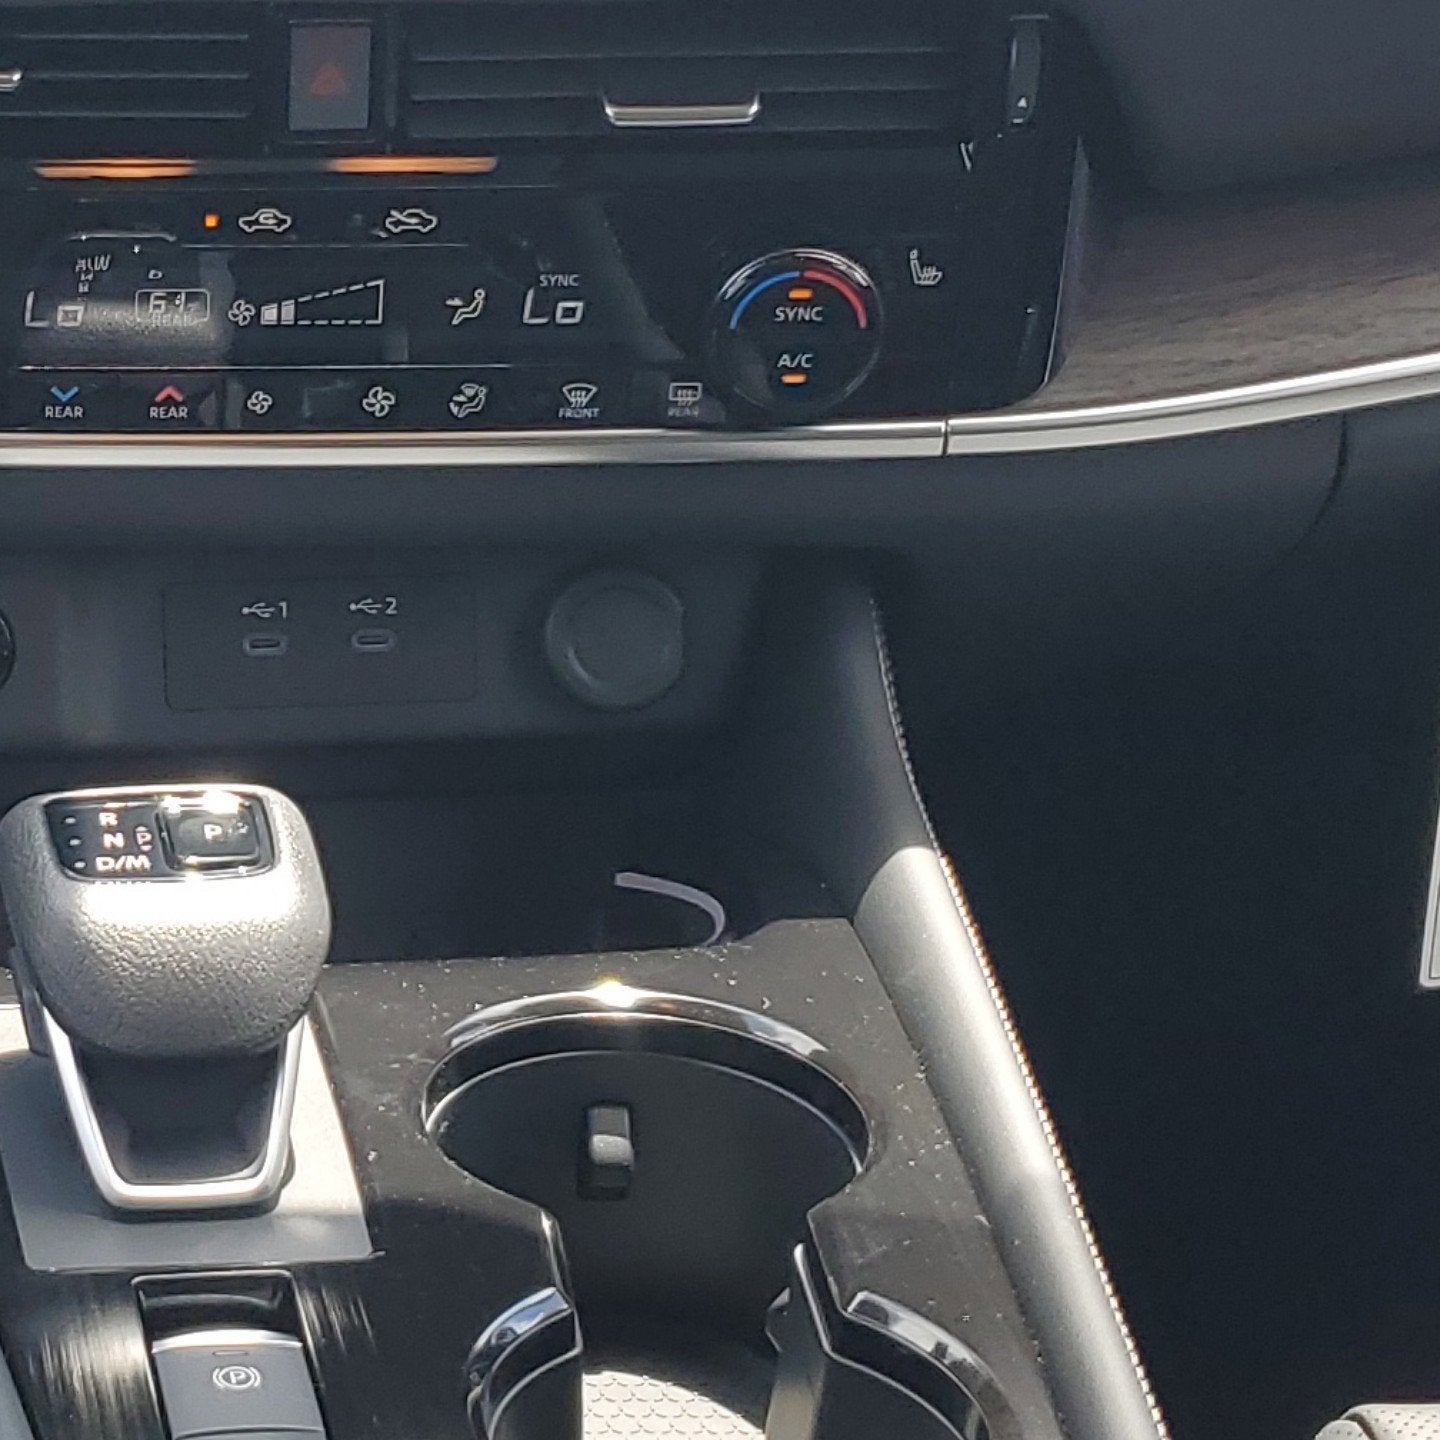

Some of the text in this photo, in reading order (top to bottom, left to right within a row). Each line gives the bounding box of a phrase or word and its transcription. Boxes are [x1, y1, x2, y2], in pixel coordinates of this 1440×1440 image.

[539, 274, 580, 287] SYNC
[774, 307, 823, 322] SYNC
[777, 353, 813, 368] A/C
[44, 405, 83, 419] REAR
[149, 405, 188, 419] REAR
[558, 407, 600, 419] FRONT
[385, 597, 398, 614] 2
[98, 811, 118, 828] R
[203, 823, 223, 841] P
[103, 832, 127, 849] N
[94, 854, 152, 872] D/M
